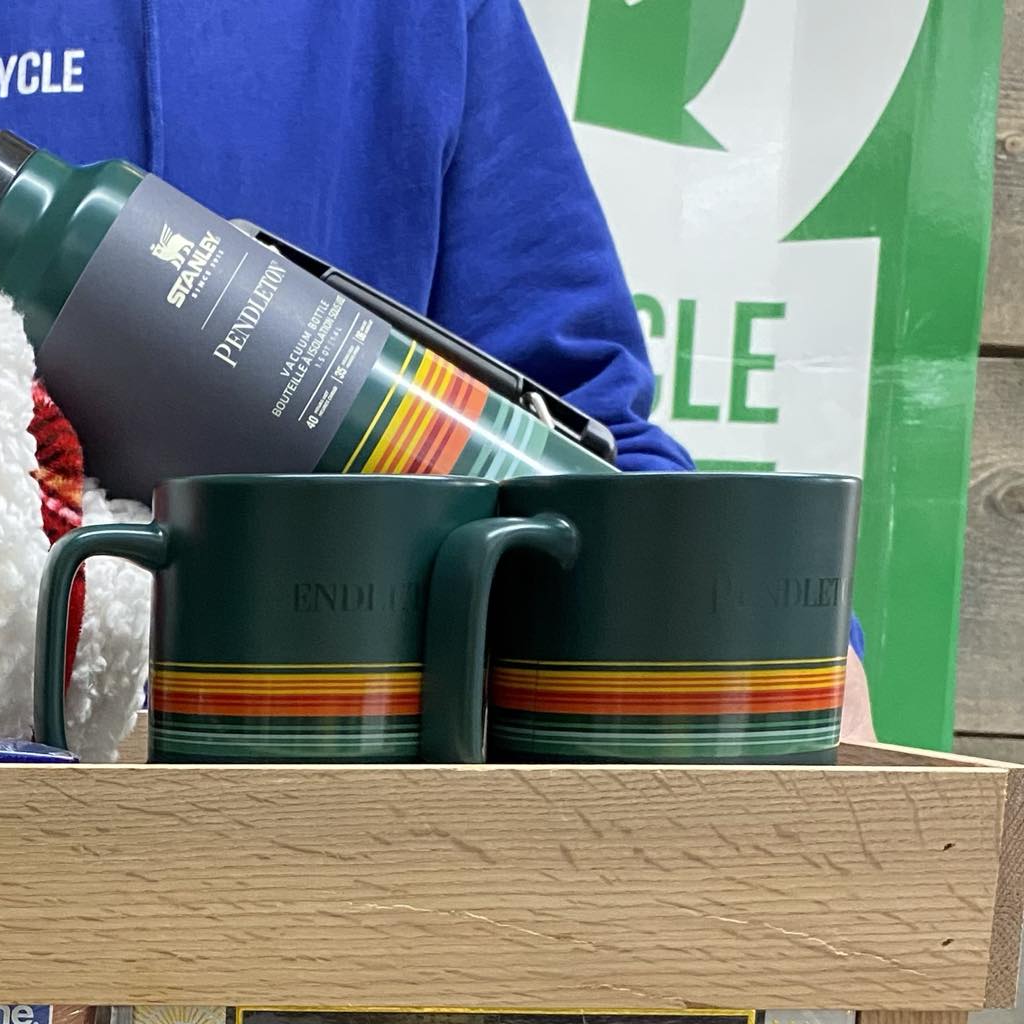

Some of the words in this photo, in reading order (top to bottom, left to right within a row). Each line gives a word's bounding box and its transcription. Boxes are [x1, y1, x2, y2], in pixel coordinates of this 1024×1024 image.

[166, 230, 222, 309] STANLEY
[191, 270, 212, 299] SINCE
[213, 259, 287, 368] PENDLETON
[279, 330, 313, 377] VACUUM
[307, 299, 330, 331] BOTTLE
[271, 363, 308, 418] BOUTEILLE
[307, 319, 335, 358] ISOLATION
[305, 415, 319, 430] 40
